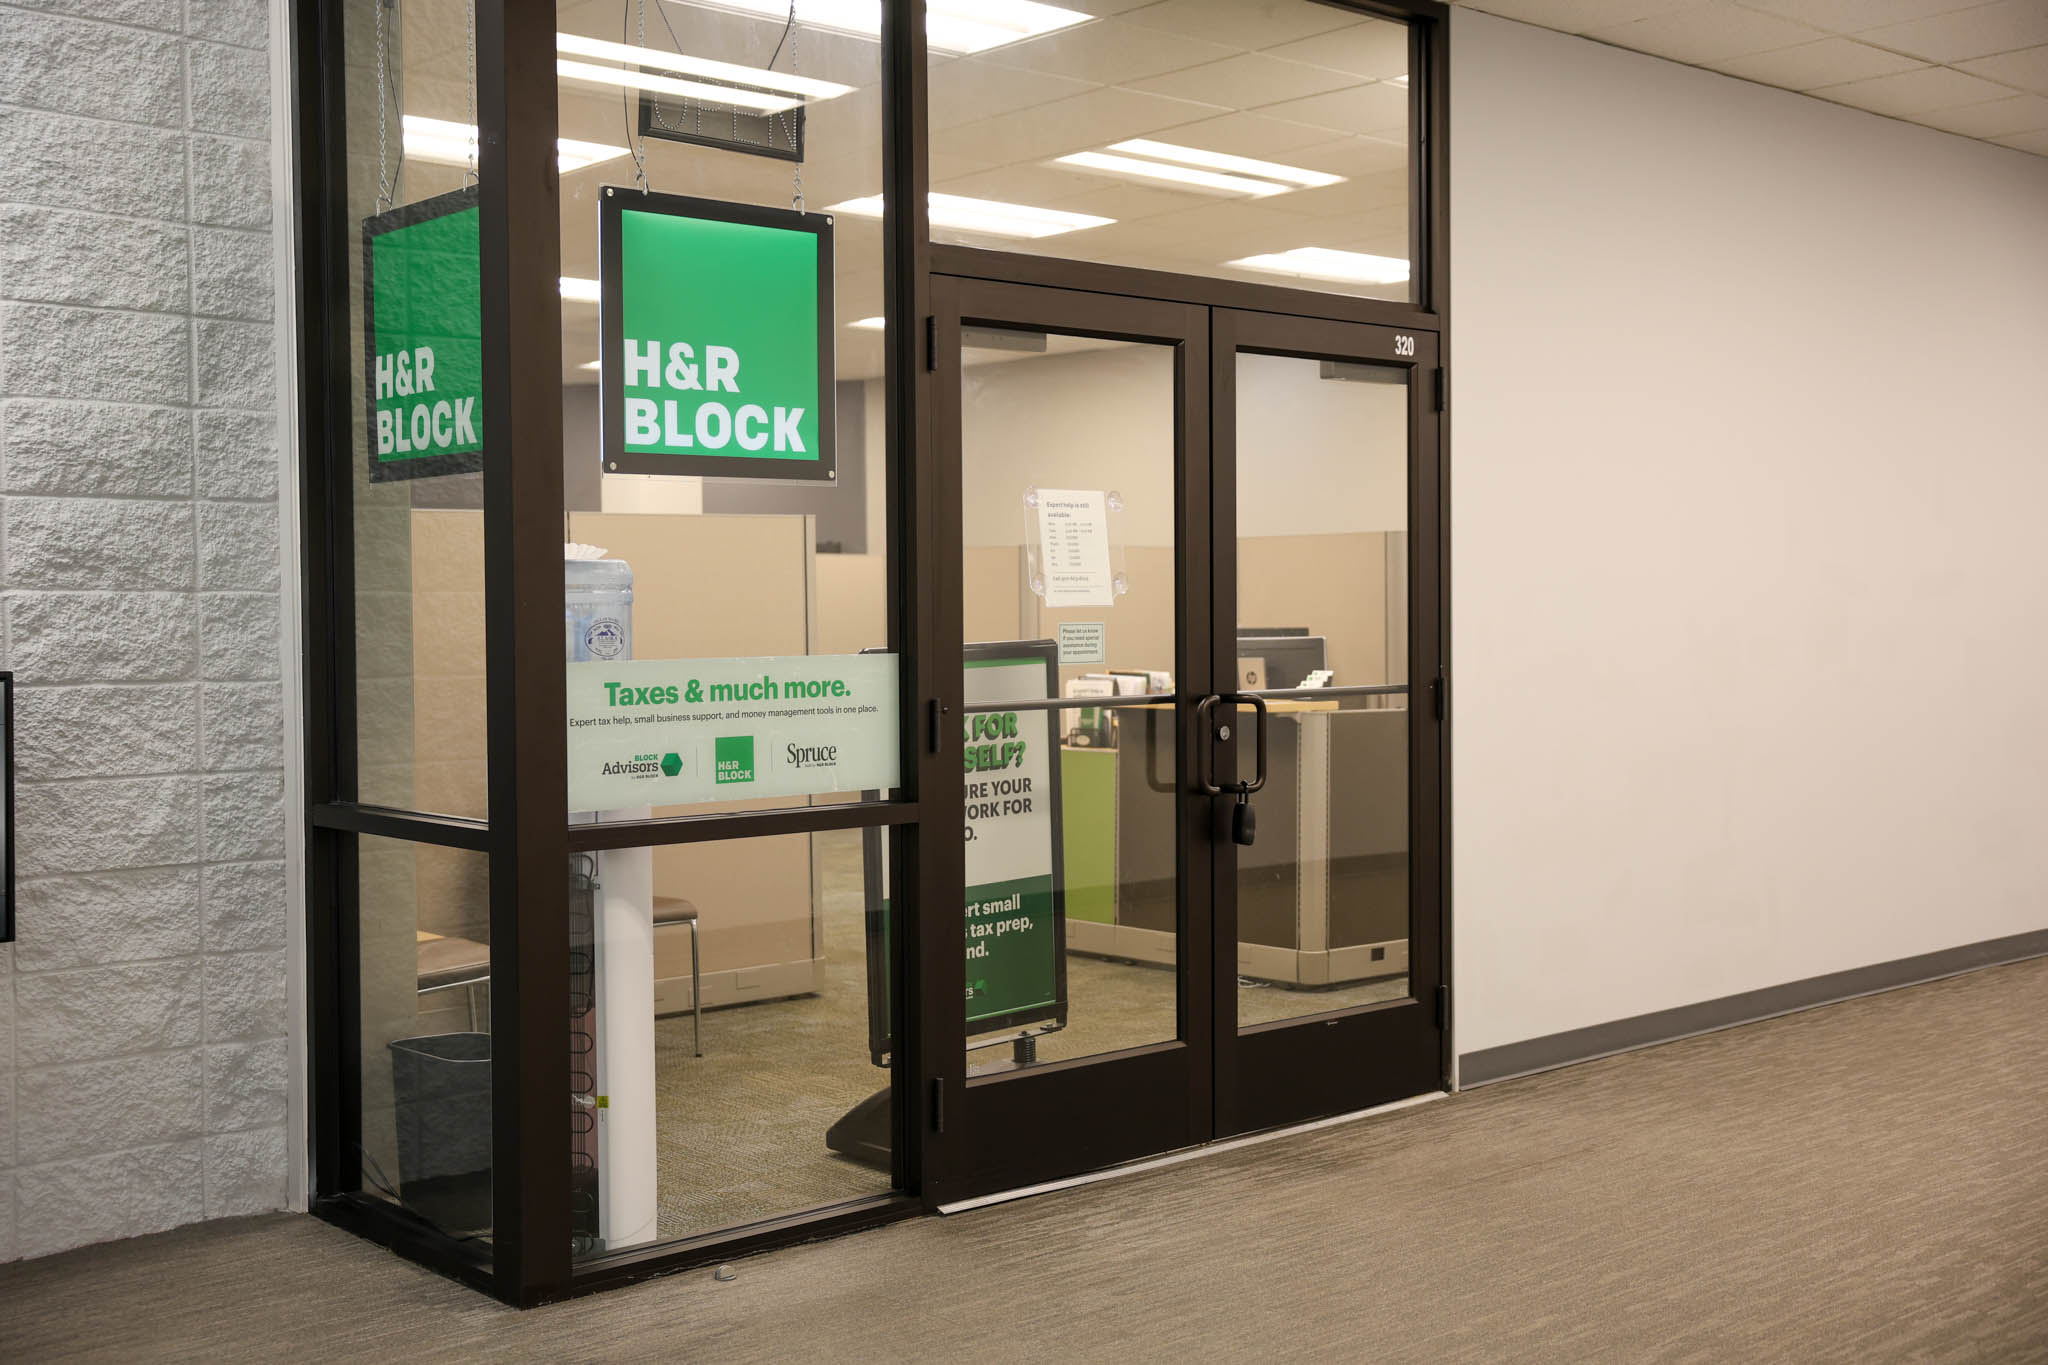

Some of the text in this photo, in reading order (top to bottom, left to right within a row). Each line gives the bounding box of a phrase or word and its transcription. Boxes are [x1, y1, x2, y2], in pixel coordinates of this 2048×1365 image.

[1395, 334, 1415, 357] 320
[375, 346, 435, 400] H&R
[624, 338, 740, 393] H&R
[376, 396, 478, 455] BLOCK
[624, 397, 807, 453] BLOCK
[603, 675, 852, 707] Taxes & much more.
[569, 704, 879, 728] Expert tax help, small business support, and money management tools in one place.
[972, 711, 1018, 742] FOR
[634, 753, 658, 761] BLOCK
[717, 760, 740, 771] H&R
[787, 743, 837, 768] Spruce
[602, 760, 659, 775] Advisors
[717, 769, 752, 781] BLOCK
[991, 777, 1033, 797] YOUR
[964, 798, 1033, 821] ORK FOR
[982, 893, 1021, 915] small
[970, 922, 994, 938] tax
[996, 916, 1034, 937] prep,
